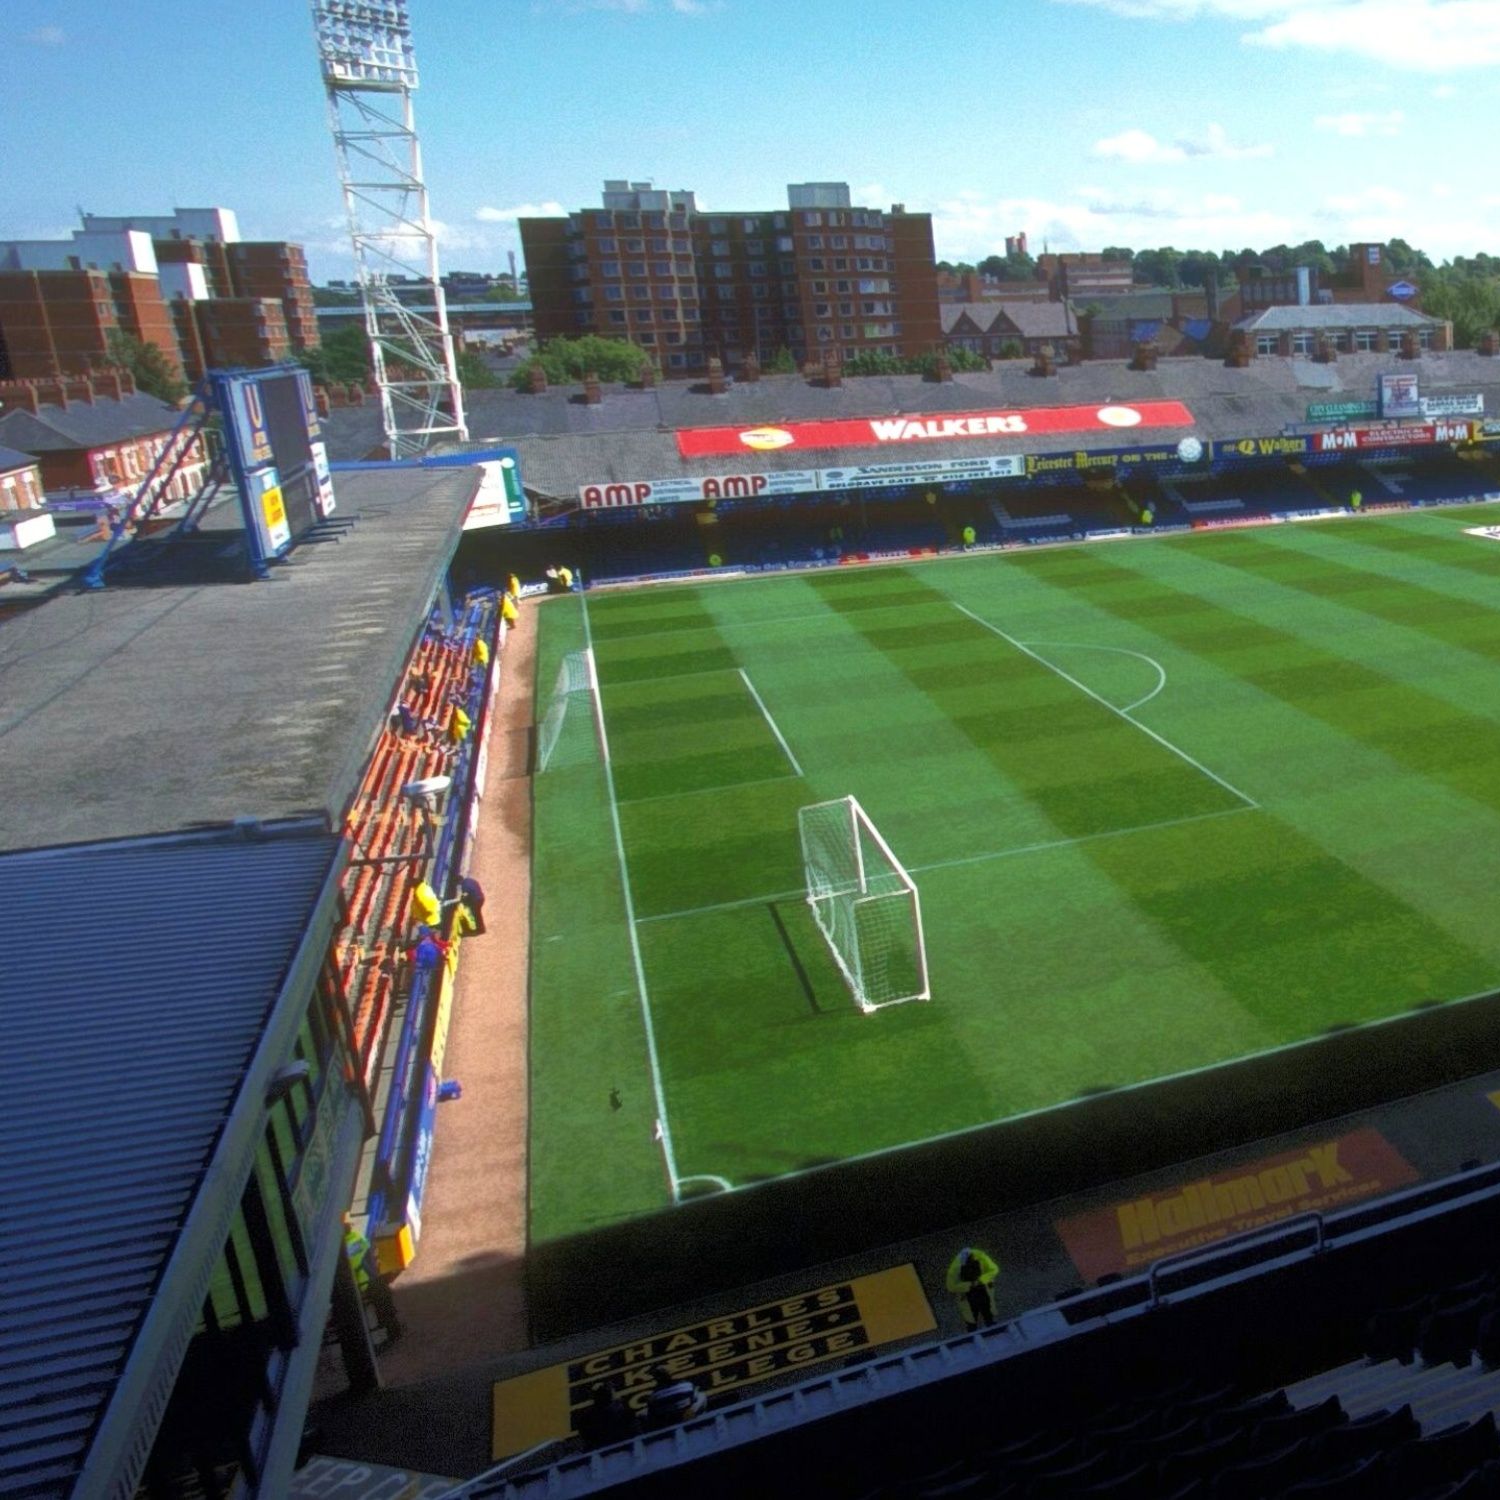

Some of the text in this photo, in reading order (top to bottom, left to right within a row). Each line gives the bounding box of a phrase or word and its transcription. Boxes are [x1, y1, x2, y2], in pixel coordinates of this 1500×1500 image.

[869, 415, 1028, 440] WALKERS
[858, 459, 985, 475] SANDERSON FORD
[1026, 455, 1073, 473] Leicester
[1075, 450, 1118, 469] Mercury
[584, 483, 652, 508] AMP
[703, 475, 768, 499] AMP
[1115, 1142, 1353, 1252] Hallmark
[584, 1288, 840, 1377] CHARLES
[624, 1322, 813, 1388] KEENE
